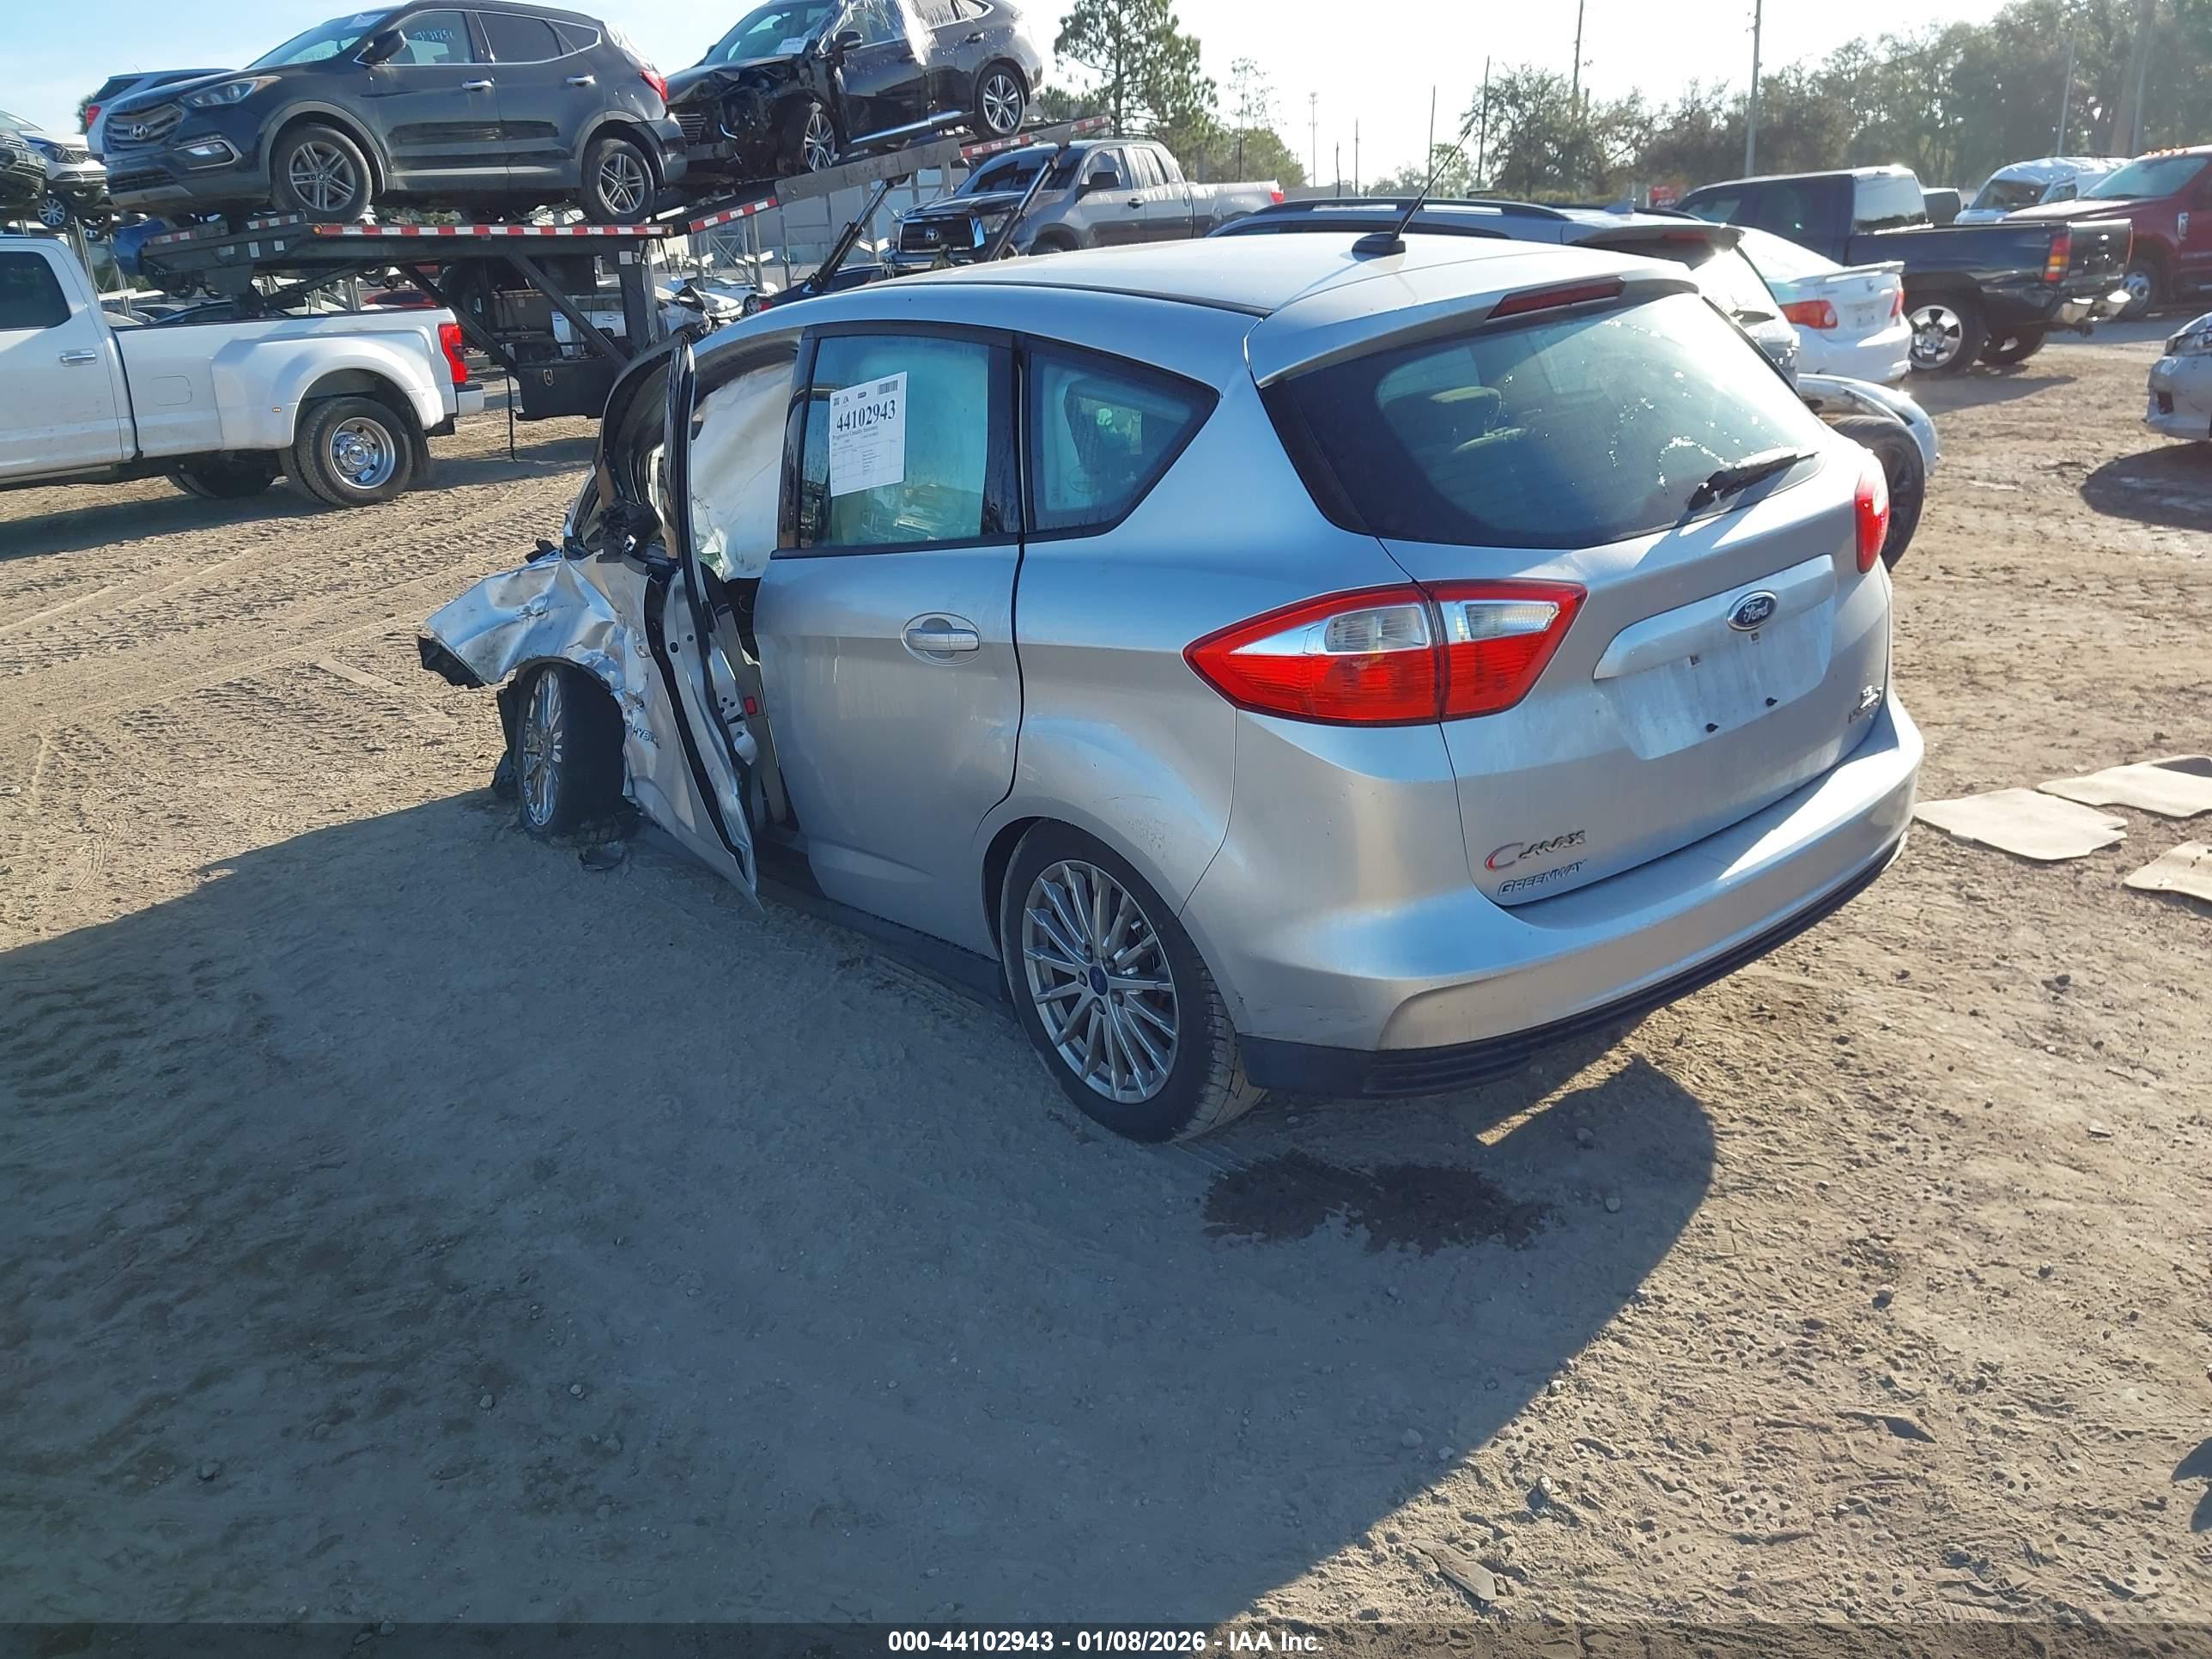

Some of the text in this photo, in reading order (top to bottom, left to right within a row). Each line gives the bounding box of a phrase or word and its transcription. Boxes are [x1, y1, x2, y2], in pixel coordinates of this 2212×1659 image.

[837, 400, 896, 432] 44102943
[1743, 600, 1769, 623] Ford
[1498, 859, 1587, 896] GREENWAY
